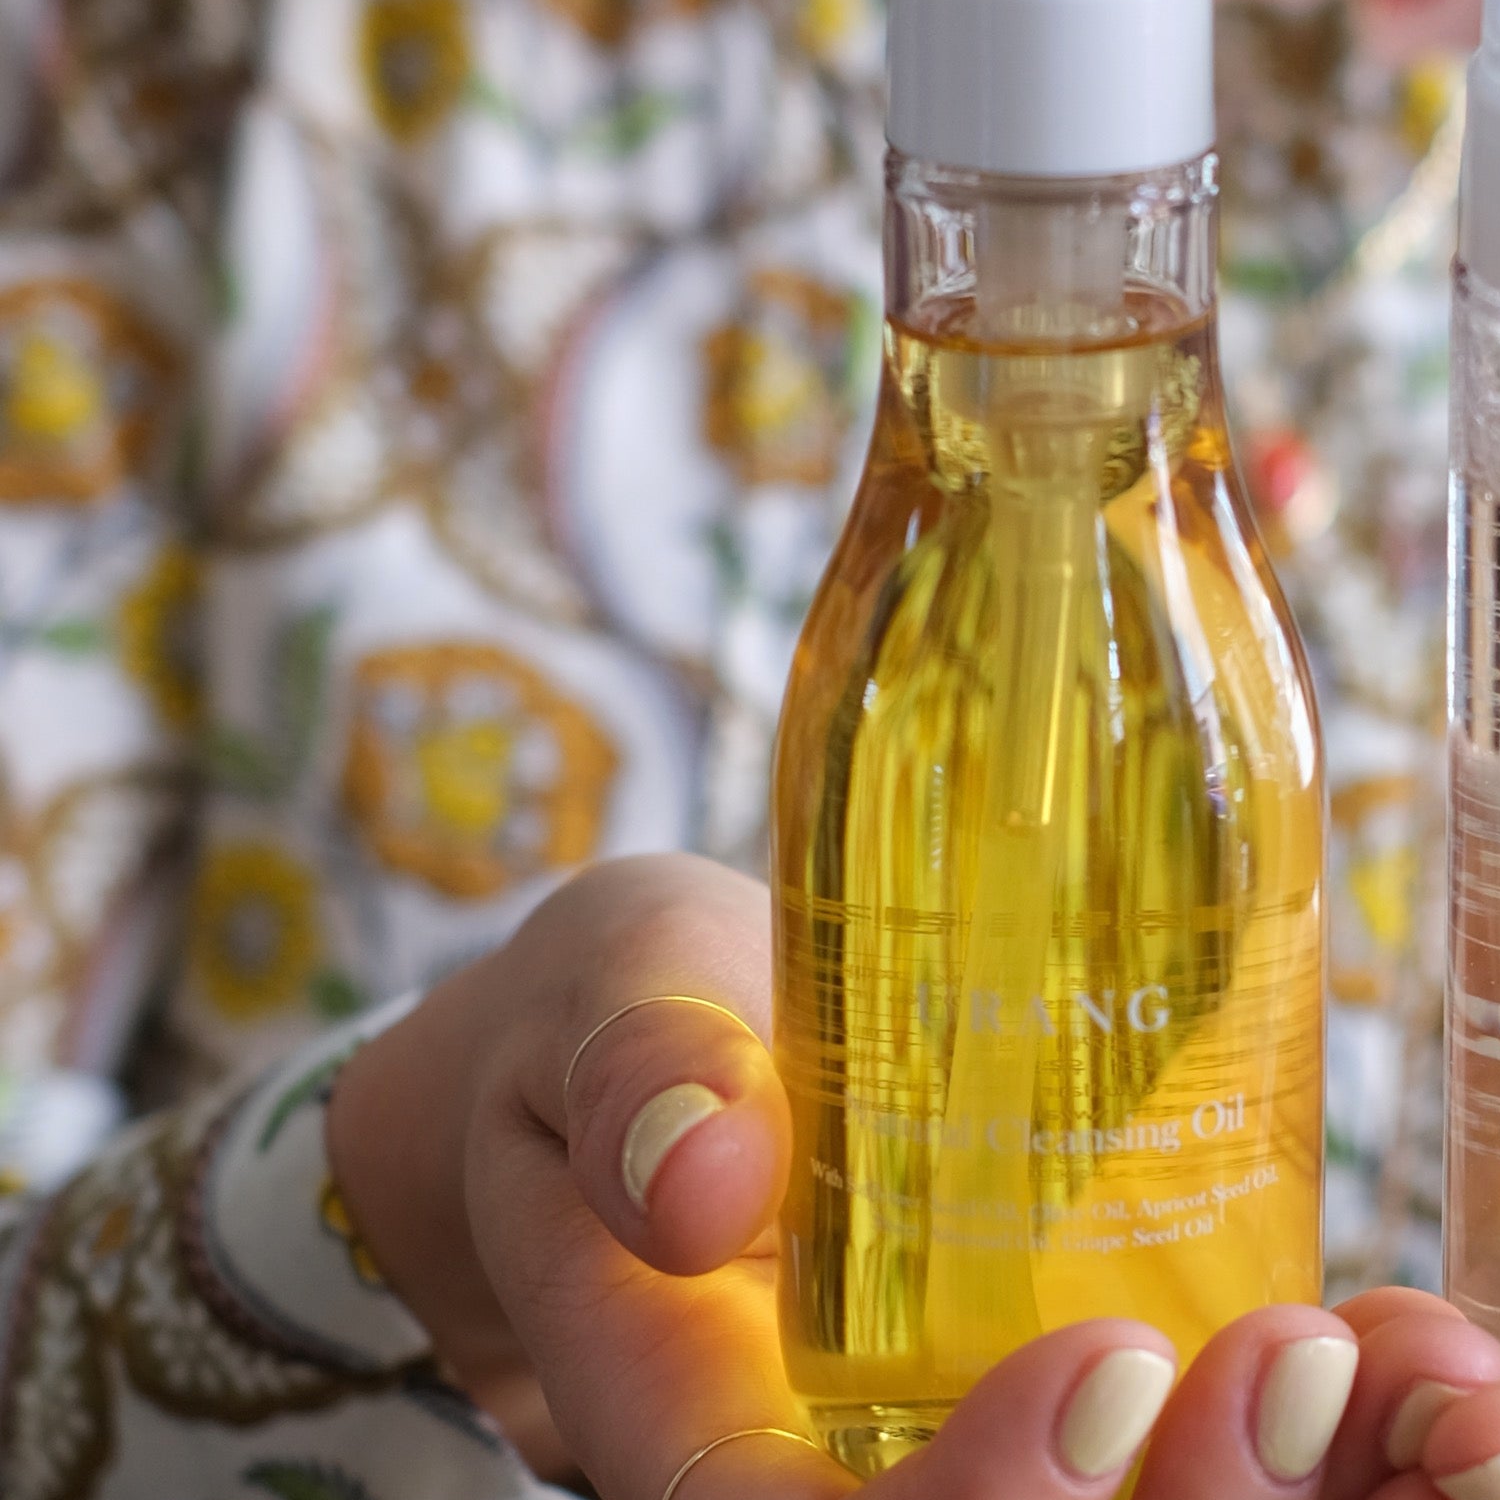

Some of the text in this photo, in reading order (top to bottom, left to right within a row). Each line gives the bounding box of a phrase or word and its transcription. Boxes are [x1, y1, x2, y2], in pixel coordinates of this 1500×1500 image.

[985, 1112, 1182, 1155] Cleansing
[1191, 1091, 1246, 1140] Oil
[1139, 1191, 1207, 1220] Apricot
[1211, 1181, 1251, 1204] Seed
[1132, 1222, 1180, 1246] Seed
[1184, 1213, 1215, 1238] Oil
